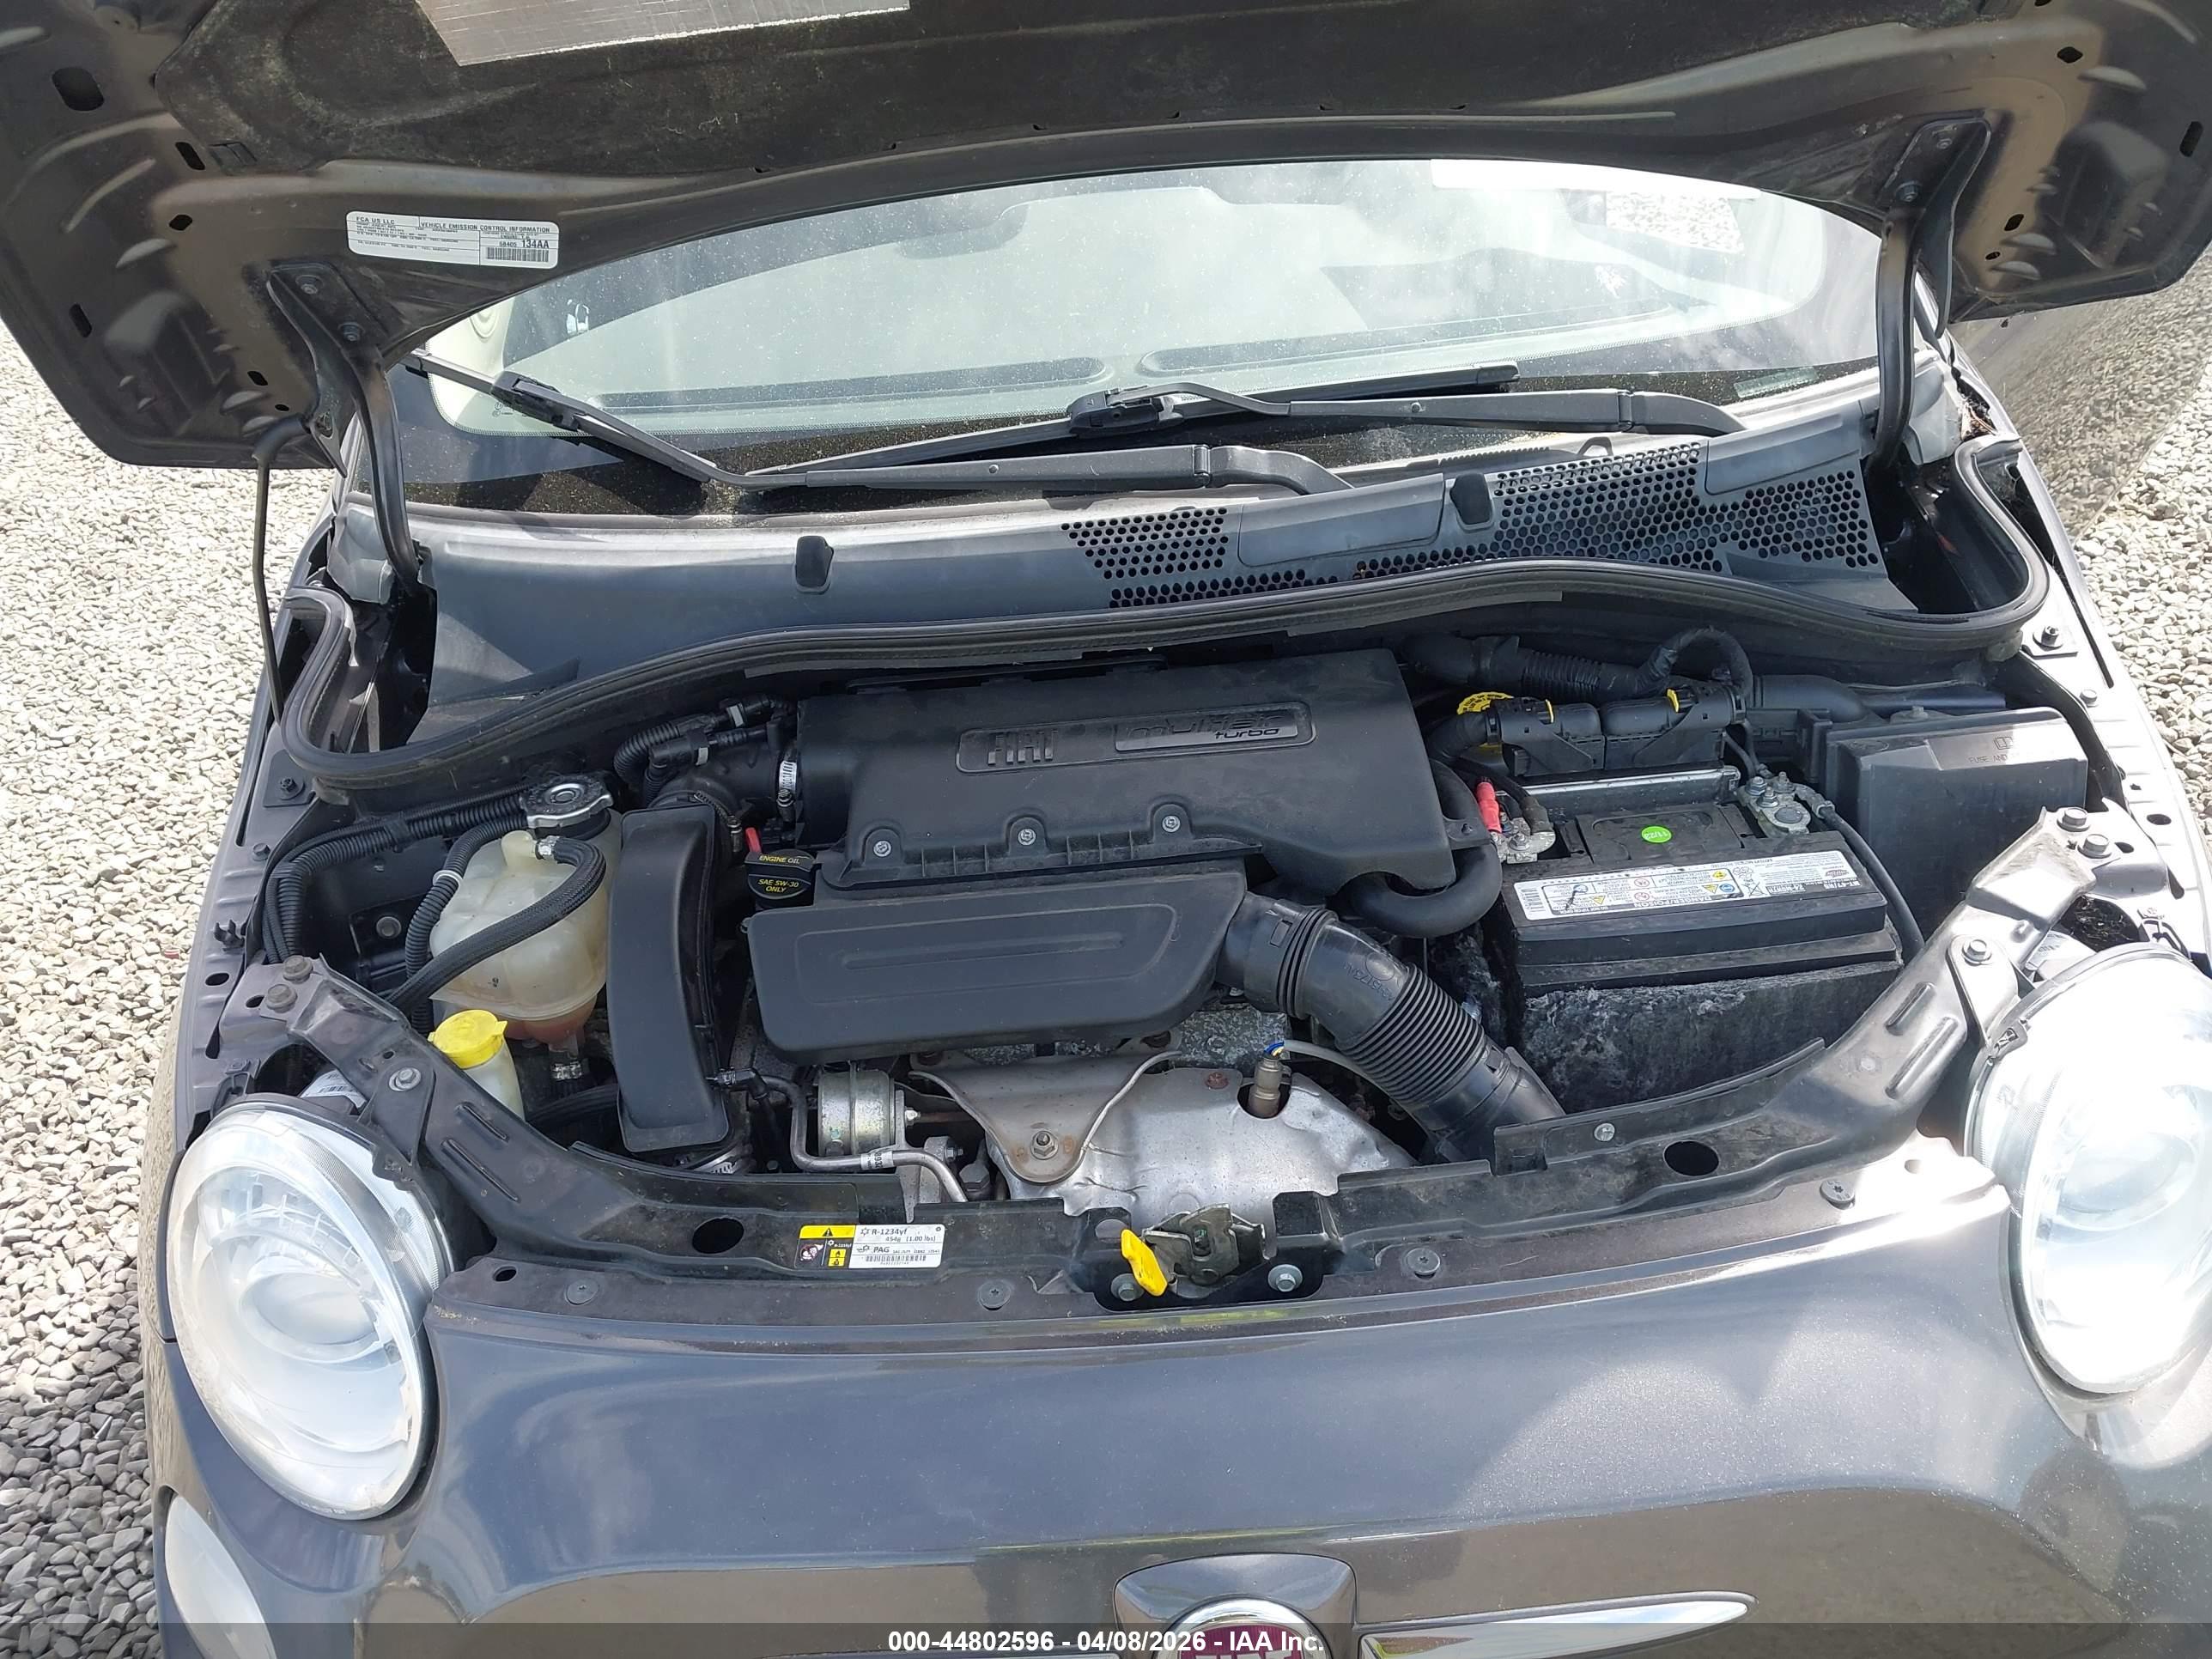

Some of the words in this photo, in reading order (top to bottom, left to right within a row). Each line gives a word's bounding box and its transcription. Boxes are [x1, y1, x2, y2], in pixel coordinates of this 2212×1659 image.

[521, 239, 550, 249] 134AA
[1215, 727, 1280, 740] turbo
[759, 854, 787, 863] ENGINE
[1633, 896, 1712, 908] DANGER/POISON
